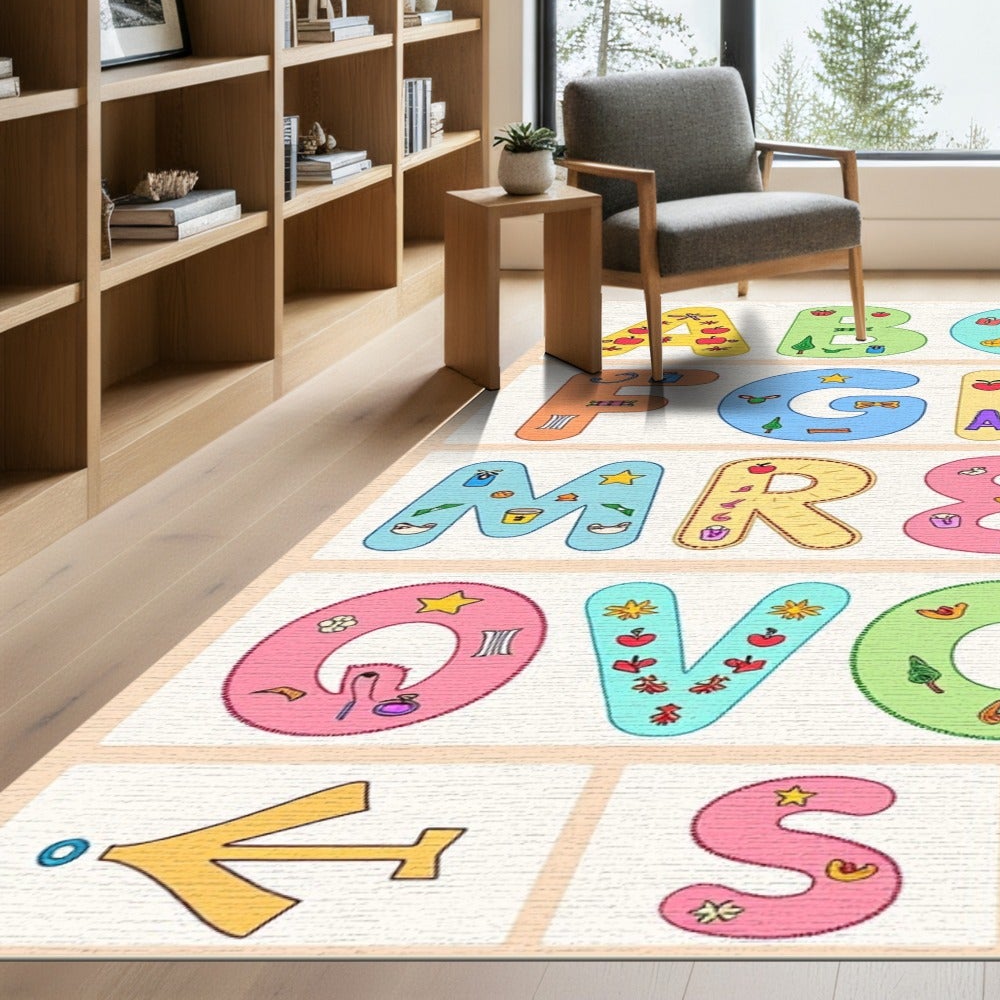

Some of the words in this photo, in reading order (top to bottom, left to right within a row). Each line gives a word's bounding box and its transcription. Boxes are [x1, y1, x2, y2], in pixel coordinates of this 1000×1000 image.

[601, 306, 750, 357] A
[776, 305, 928, 358] B
[717, 368, 927, 442] G
[362, 460, 665, 551] M
[673, 457, 877, 550] R
[585, 582, 851, 737] V
[658, 776, 902, 939] S
